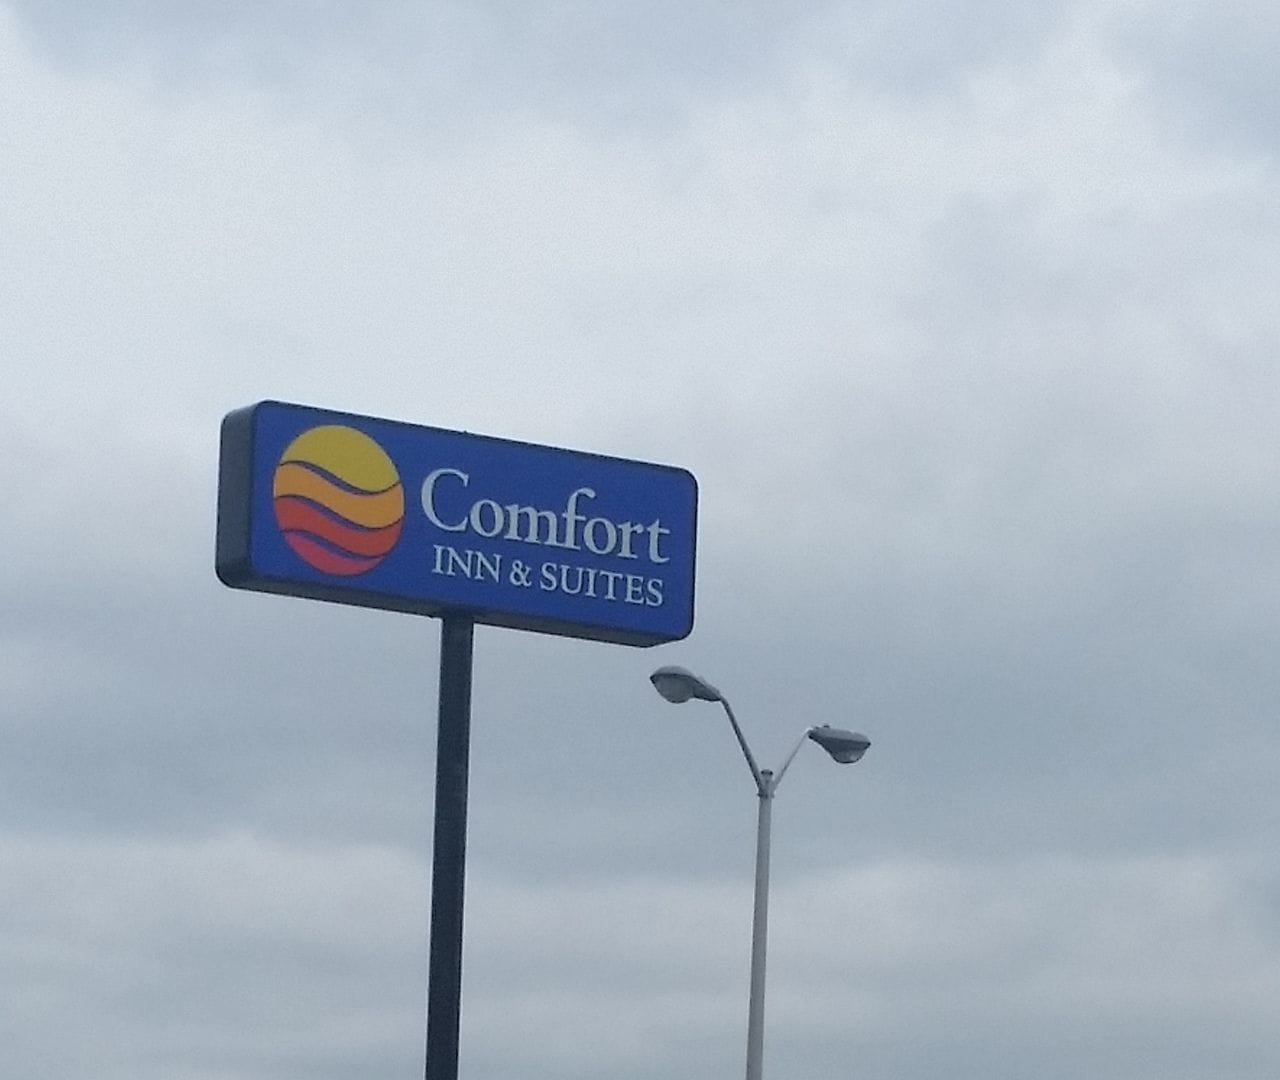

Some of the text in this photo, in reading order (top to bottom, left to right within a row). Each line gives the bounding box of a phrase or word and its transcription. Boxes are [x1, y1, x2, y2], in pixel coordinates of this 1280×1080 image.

[421, 468, 670, 563] Comfort
[431, 544, 664, 607] INN & SUITES
